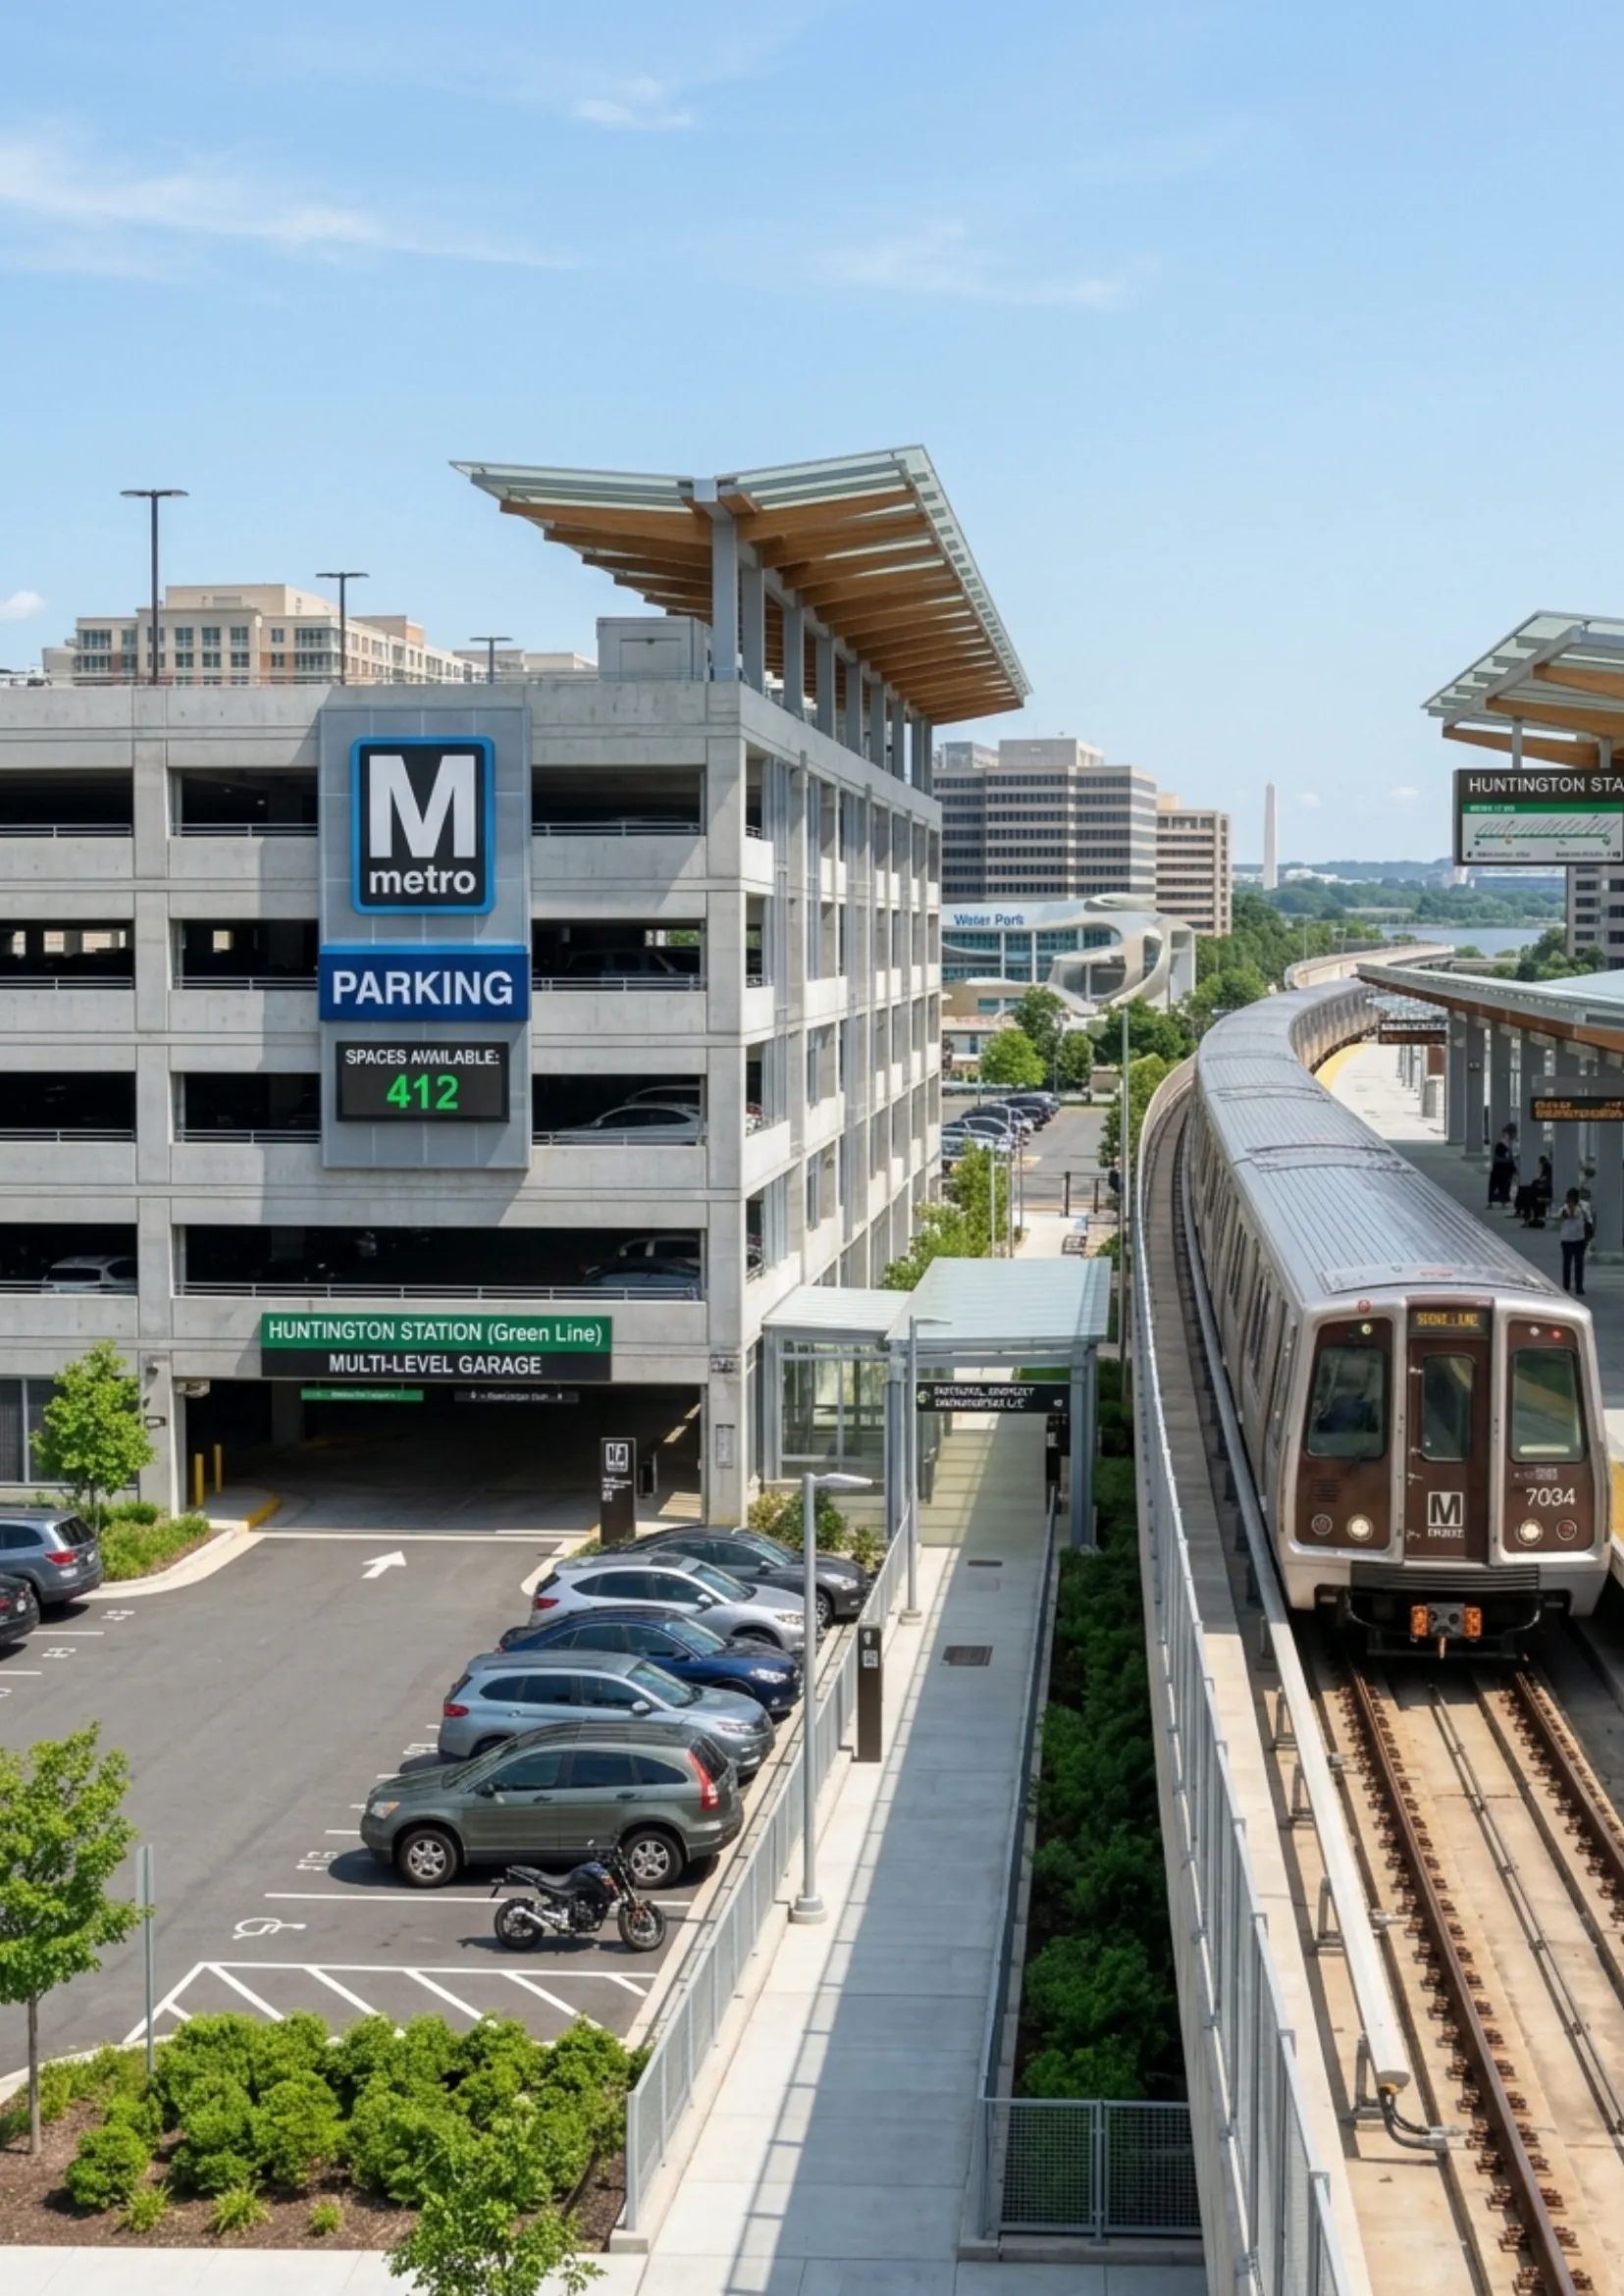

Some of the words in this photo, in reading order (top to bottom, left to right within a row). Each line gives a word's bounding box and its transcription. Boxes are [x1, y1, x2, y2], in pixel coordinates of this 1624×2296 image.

[1469, 776, 1586, 793] HUNTINGTON
[369, 755, 476, 859] M
[369, 864, 476, 895] metro
[333, 970, 513, 1006] PARKING
[345, 1049, 407, 1066] SPACES
[387, 1073, 458, 1110] 412
[269, 1321, 395, 1340] HUNTINGTON
[400, 1322, 482, 1341] STATION
[488, 1323, 550, 1344] (Green
[555, 1325, 602, 1345] Line)
[329, 1353, 454, 1374] MULTI-LEVEL
[458, 1355, 542, 1375] GARAGE
[1429, 1493, 1462, 1525] M
[1526, 1487, 1576, 1507] 7034
